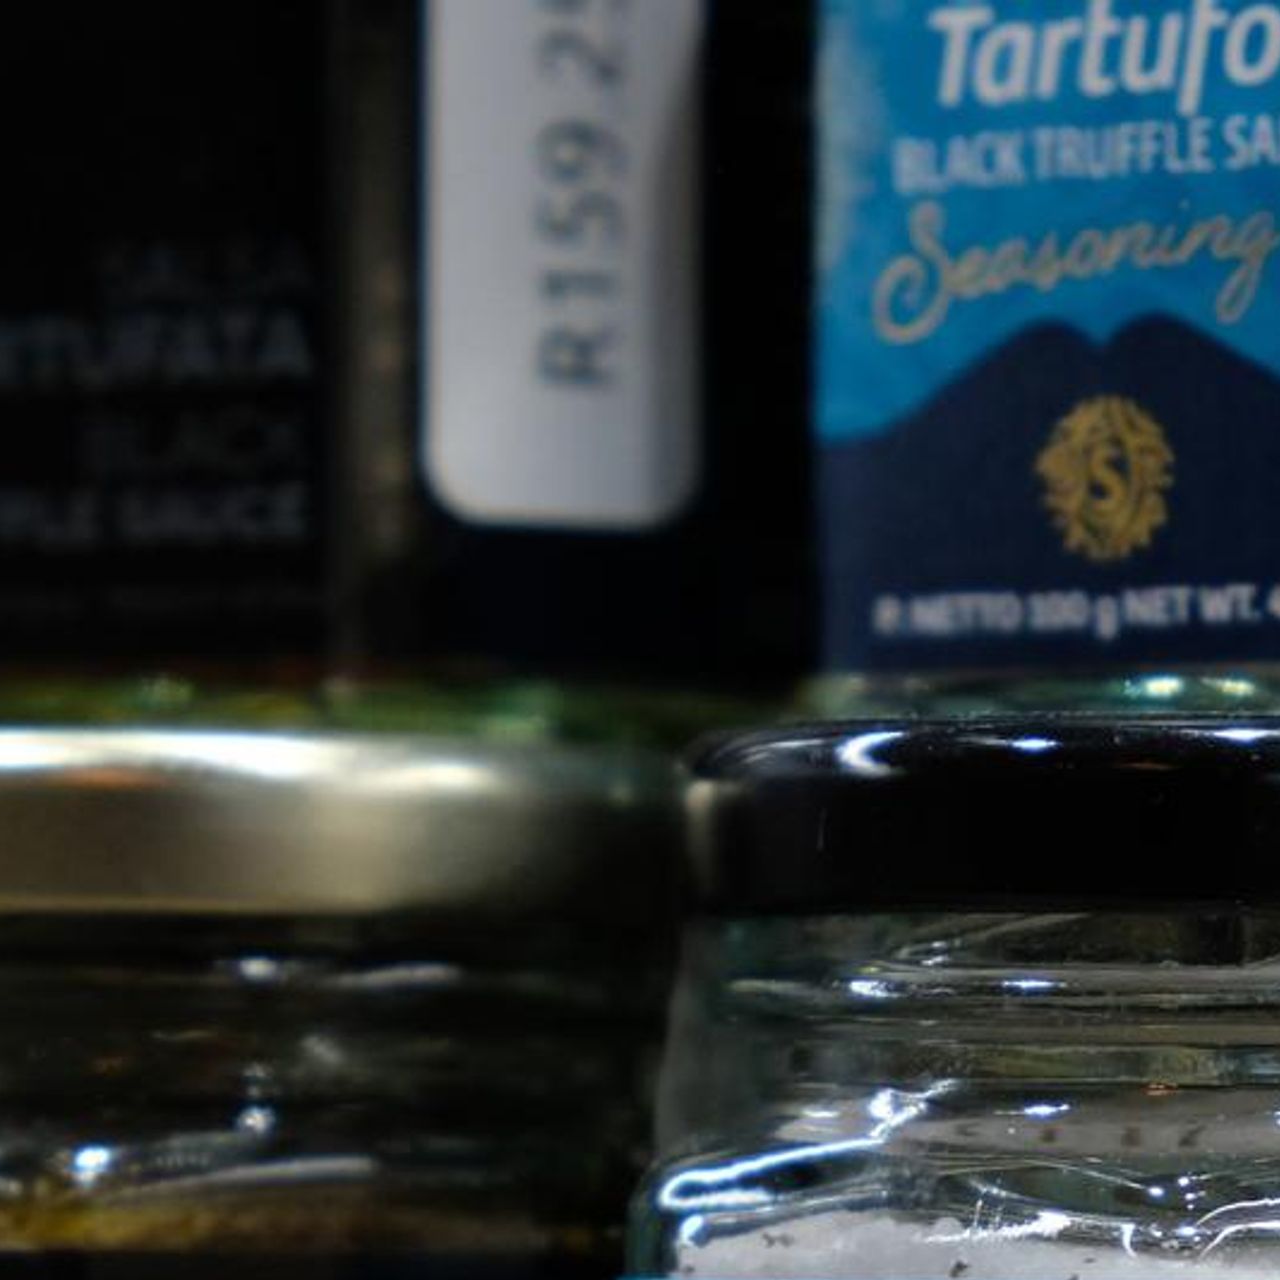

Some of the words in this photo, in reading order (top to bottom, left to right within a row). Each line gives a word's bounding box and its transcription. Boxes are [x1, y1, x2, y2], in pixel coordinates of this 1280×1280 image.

[893, 131, 1025, 193] BLACK
[1035, 118, 1213, 181] TRUFFLE
[1122, 584, 1192, 627] NET
